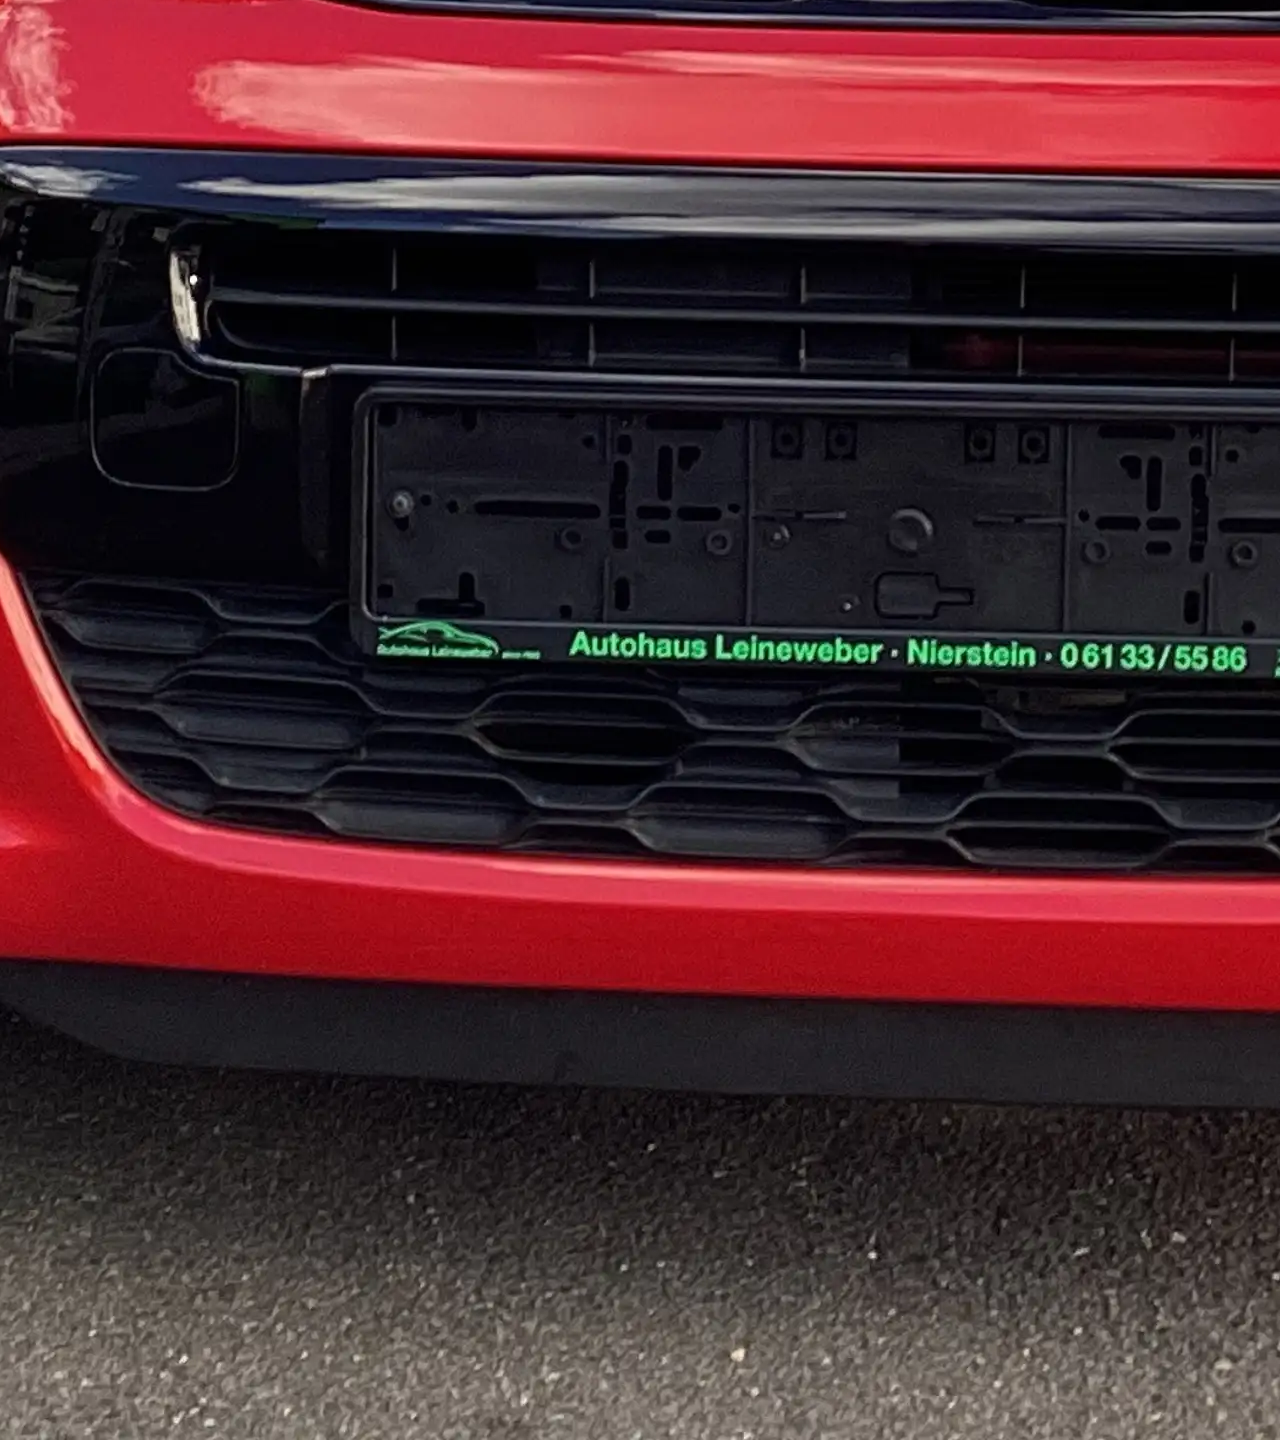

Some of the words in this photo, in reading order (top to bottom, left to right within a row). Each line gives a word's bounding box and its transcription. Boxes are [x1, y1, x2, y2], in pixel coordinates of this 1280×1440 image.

[569, 630, 707, 660] Autohaus
[715, 634, 882, 664] Leineweber
[907, 638, 1036, 667] Nierstein
